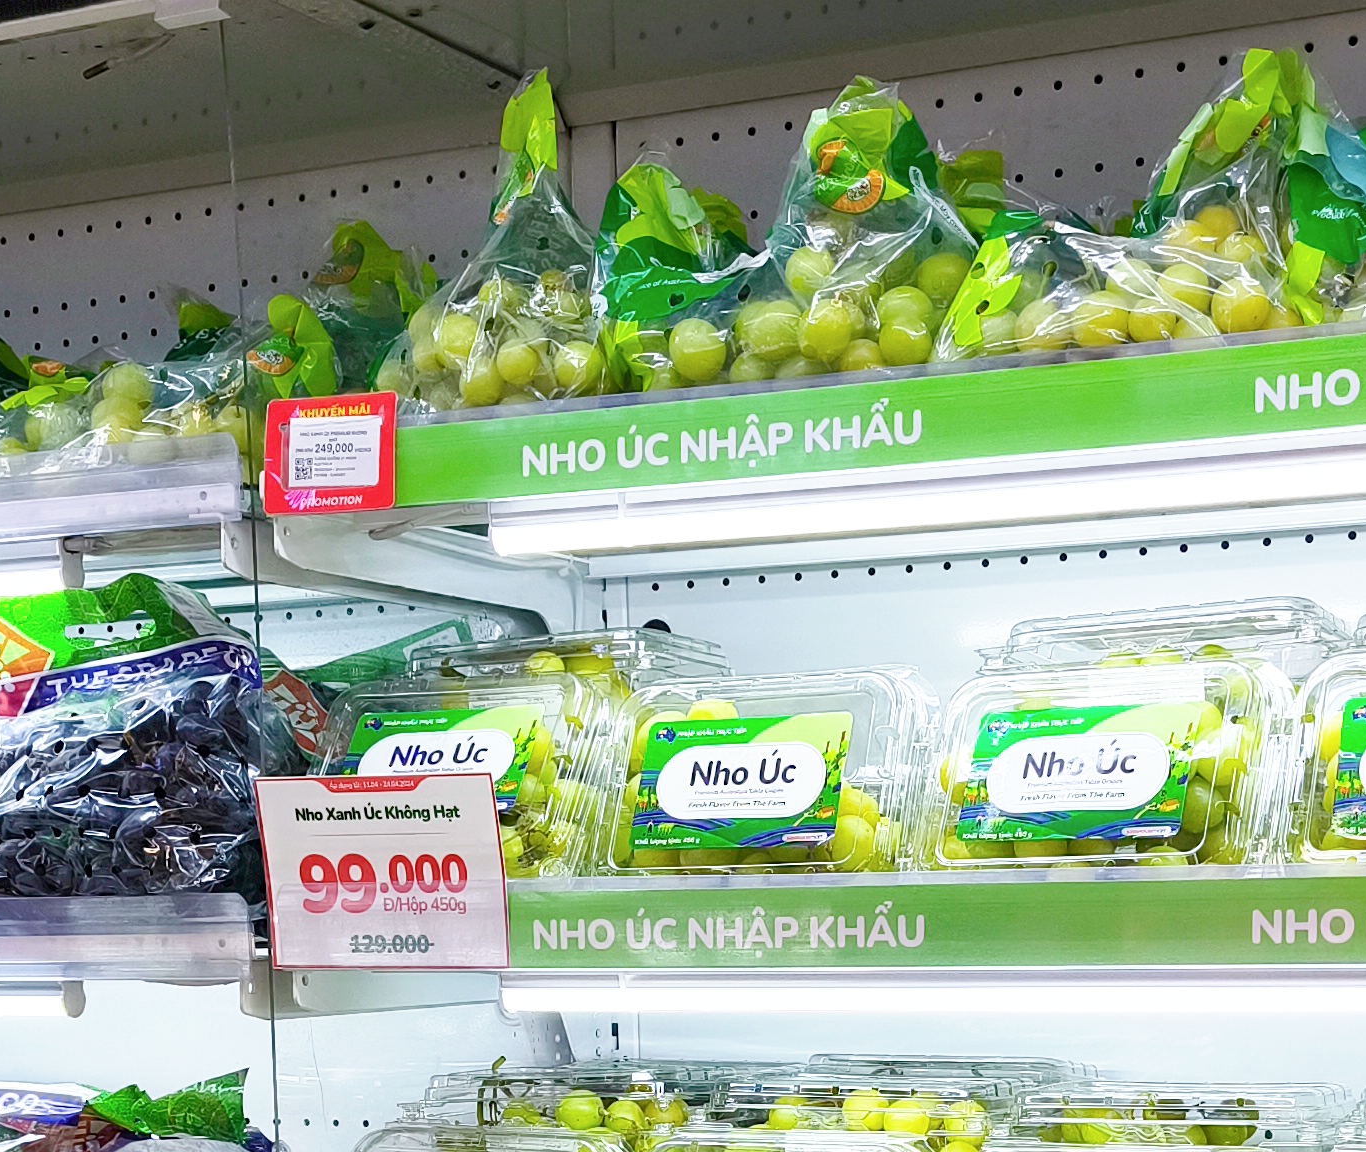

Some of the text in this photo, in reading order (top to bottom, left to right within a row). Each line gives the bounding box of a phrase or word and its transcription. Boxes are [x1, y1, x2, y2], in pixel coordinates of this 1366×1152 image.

[1255, 369, 1360, 413] NHO
[299, 402, 371, 418] KHUYẾN MÃI
[315, 442, 353, 455] 249,000
[523, 398, 922, 477] NHO ÚC NHẬP KHẨU
[690, 750, 796, 786] Nho Úc
[295, 802, 460, 822] Nho Xanh Úc Không Hạt
[300, 853, 467, 914] 99.000
[383, 897, 467, 916] Đ/Hộp 450g
[533, 901, 925, 959] NHO ÚC NHẬP KHẨU
[1252, 909, 1355, 944] NHO
[350, 935, 434, 954] 129.000
